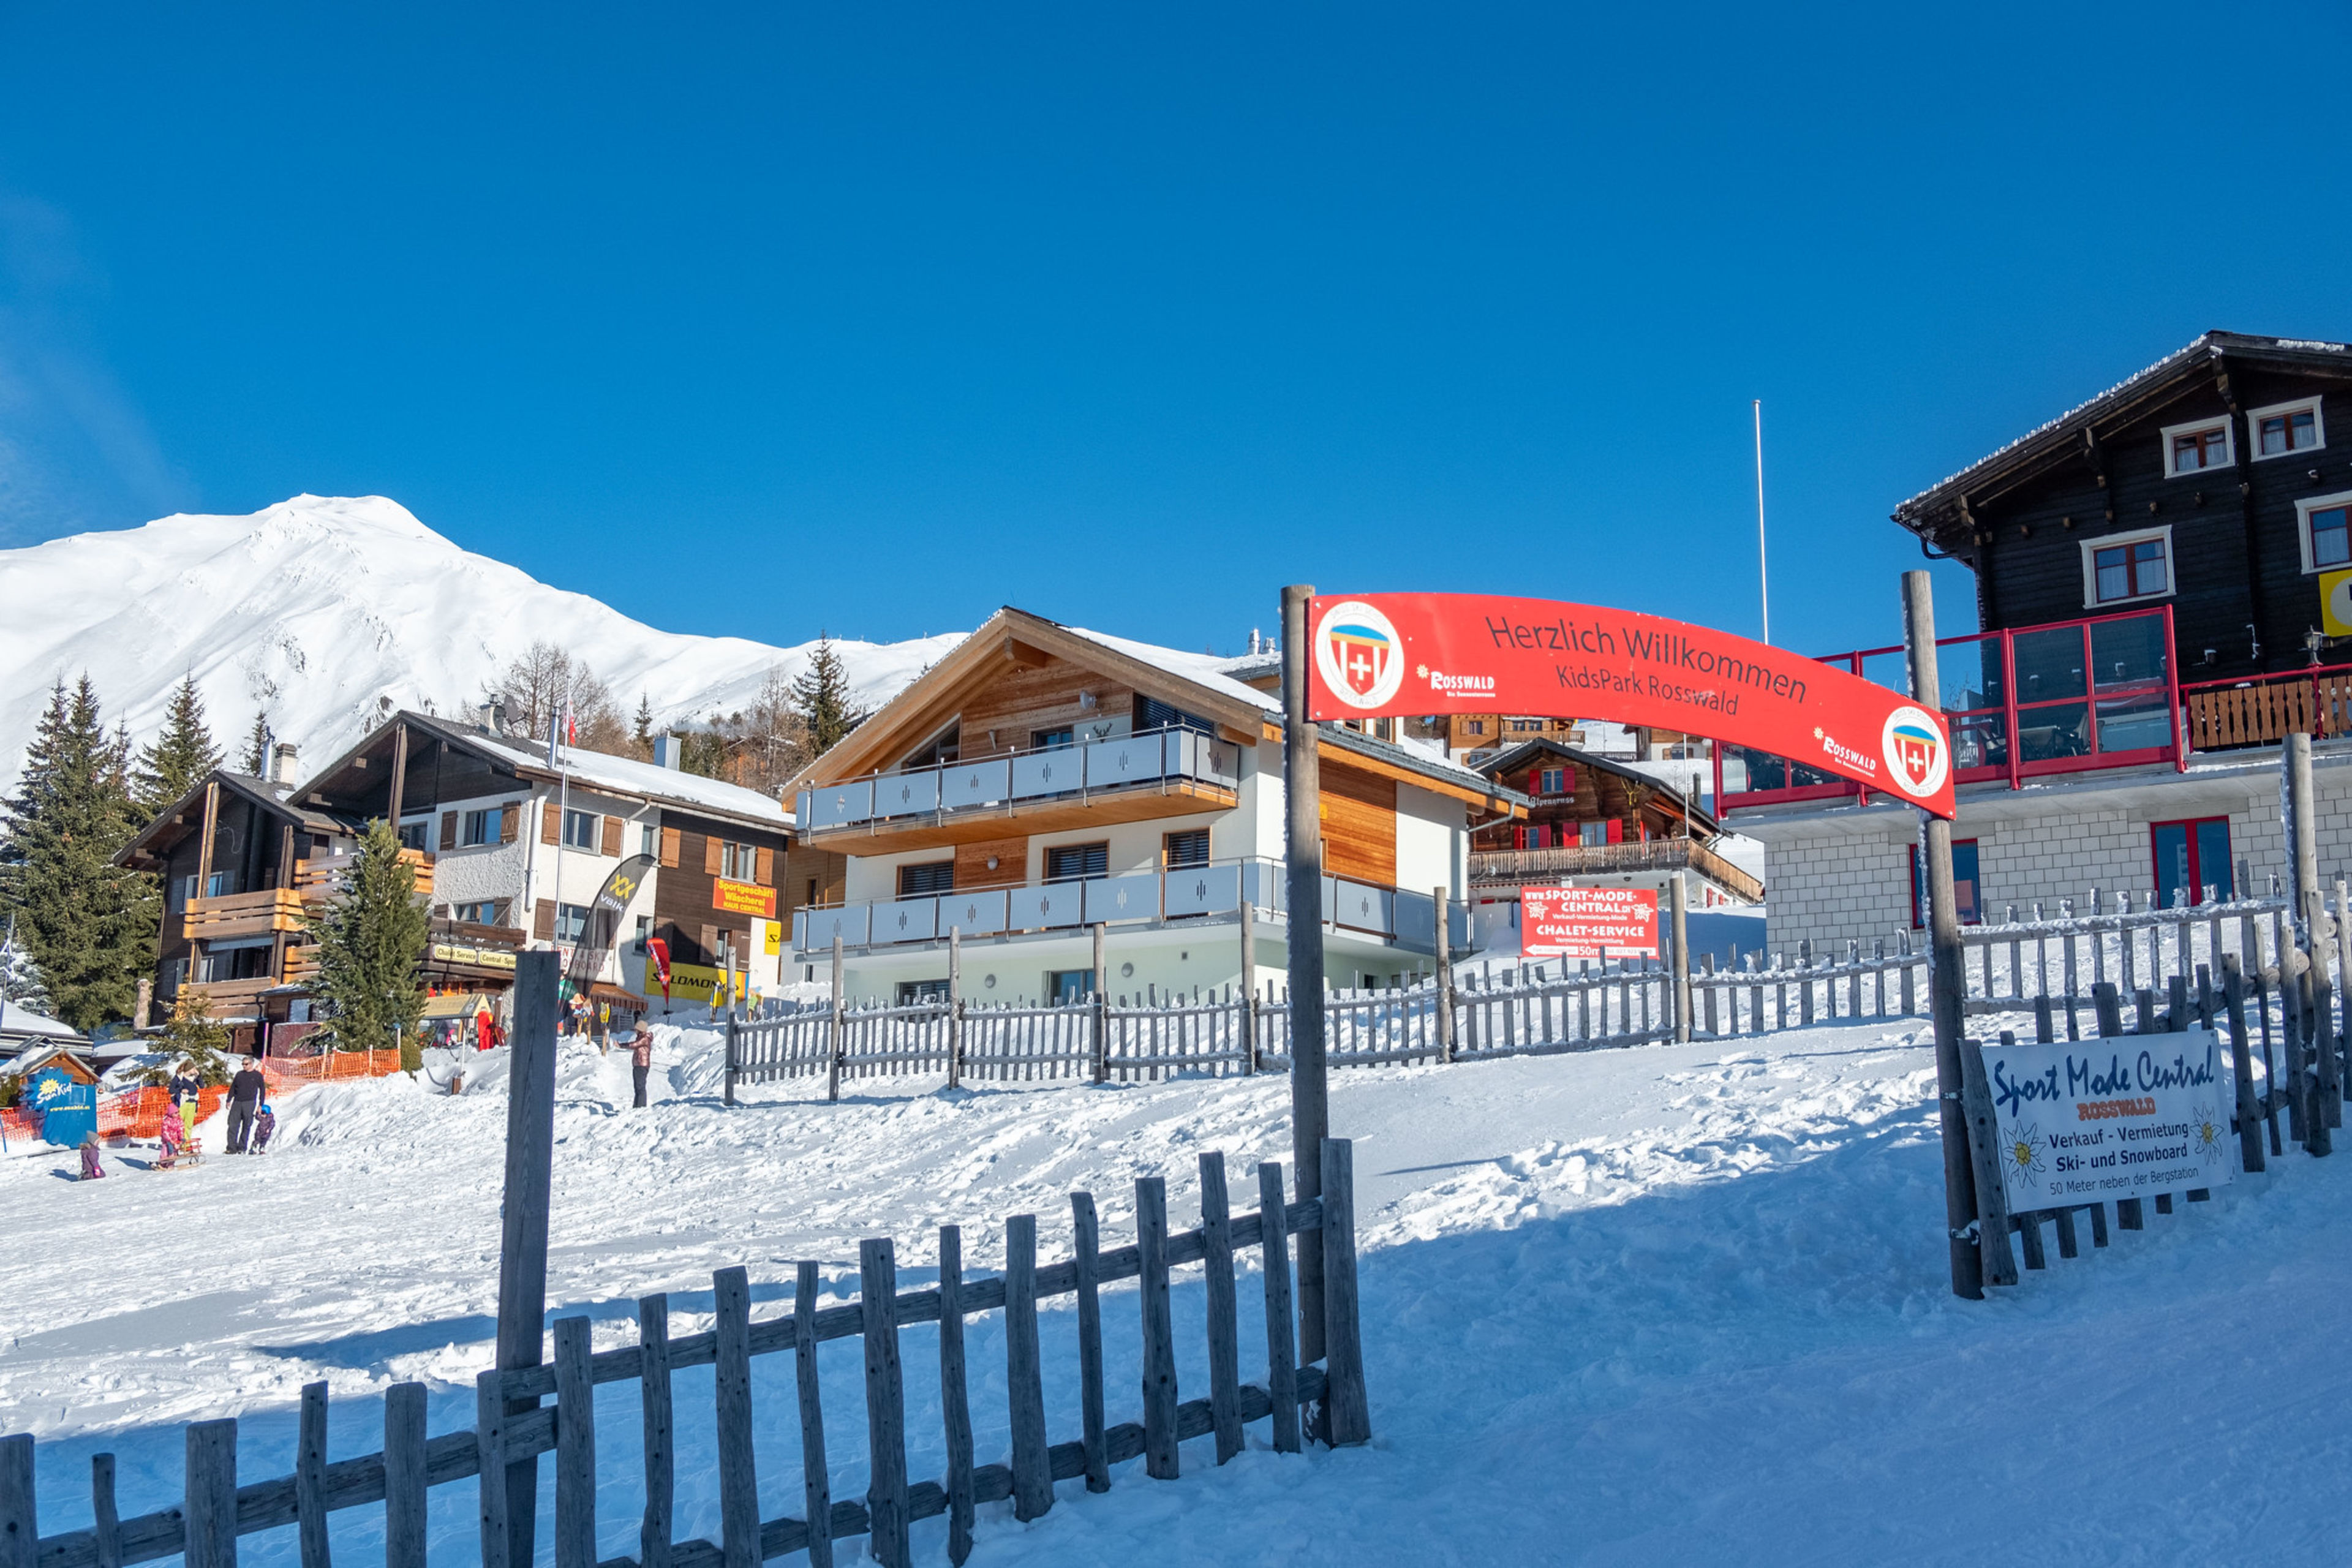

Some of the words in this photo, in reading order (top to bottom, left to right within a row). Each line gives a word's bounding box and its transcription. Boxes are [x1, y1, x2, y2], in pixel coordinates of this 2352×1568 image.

[1485, 616, 1615, 655] Herzlich
[1623, 627, 1807, 704] Willkommen
[1556, 665, 1644, 695] KidsPark
[1648, 675, 1739, 715] Rosswald
[718, 879, 774, 899] Sportgeschäft
[724, 891, 766, 907] Wäscherei
[723, 900, 739, 910] HAUS
[739, 903, 765, 914] CENTRAL
[1536, 924, 1645, 937] CHALET-SERVICE
[482, 954, 502, 963] Central
[1994, 1060, 2060, 1118] Sport
[2066, 1054, 2132, 1098] Mode
[2136, 1044, 2214, 1092] Central
[2077, 1097, 2156, 1121] ROSSWALD
[2049, 1128, 2105, 1149] Verkauf
[2117, 1121, 2189, 1143] Vermietung
[2056, 1157, 2086, 1172] Ski-
[2090, 1150, 2116, 1169] und
[2120, 1142, 2188, 1165] Snowboard
[2049, 1182, 2064, 1196] 50
[2066, 1179, 2096, 1193] Meter
[2099, 1175, 2131, 1189] neben
[2133, 1172, 2148, 1186] der
[2150, 1166, 2199, 1184] Bergstation
